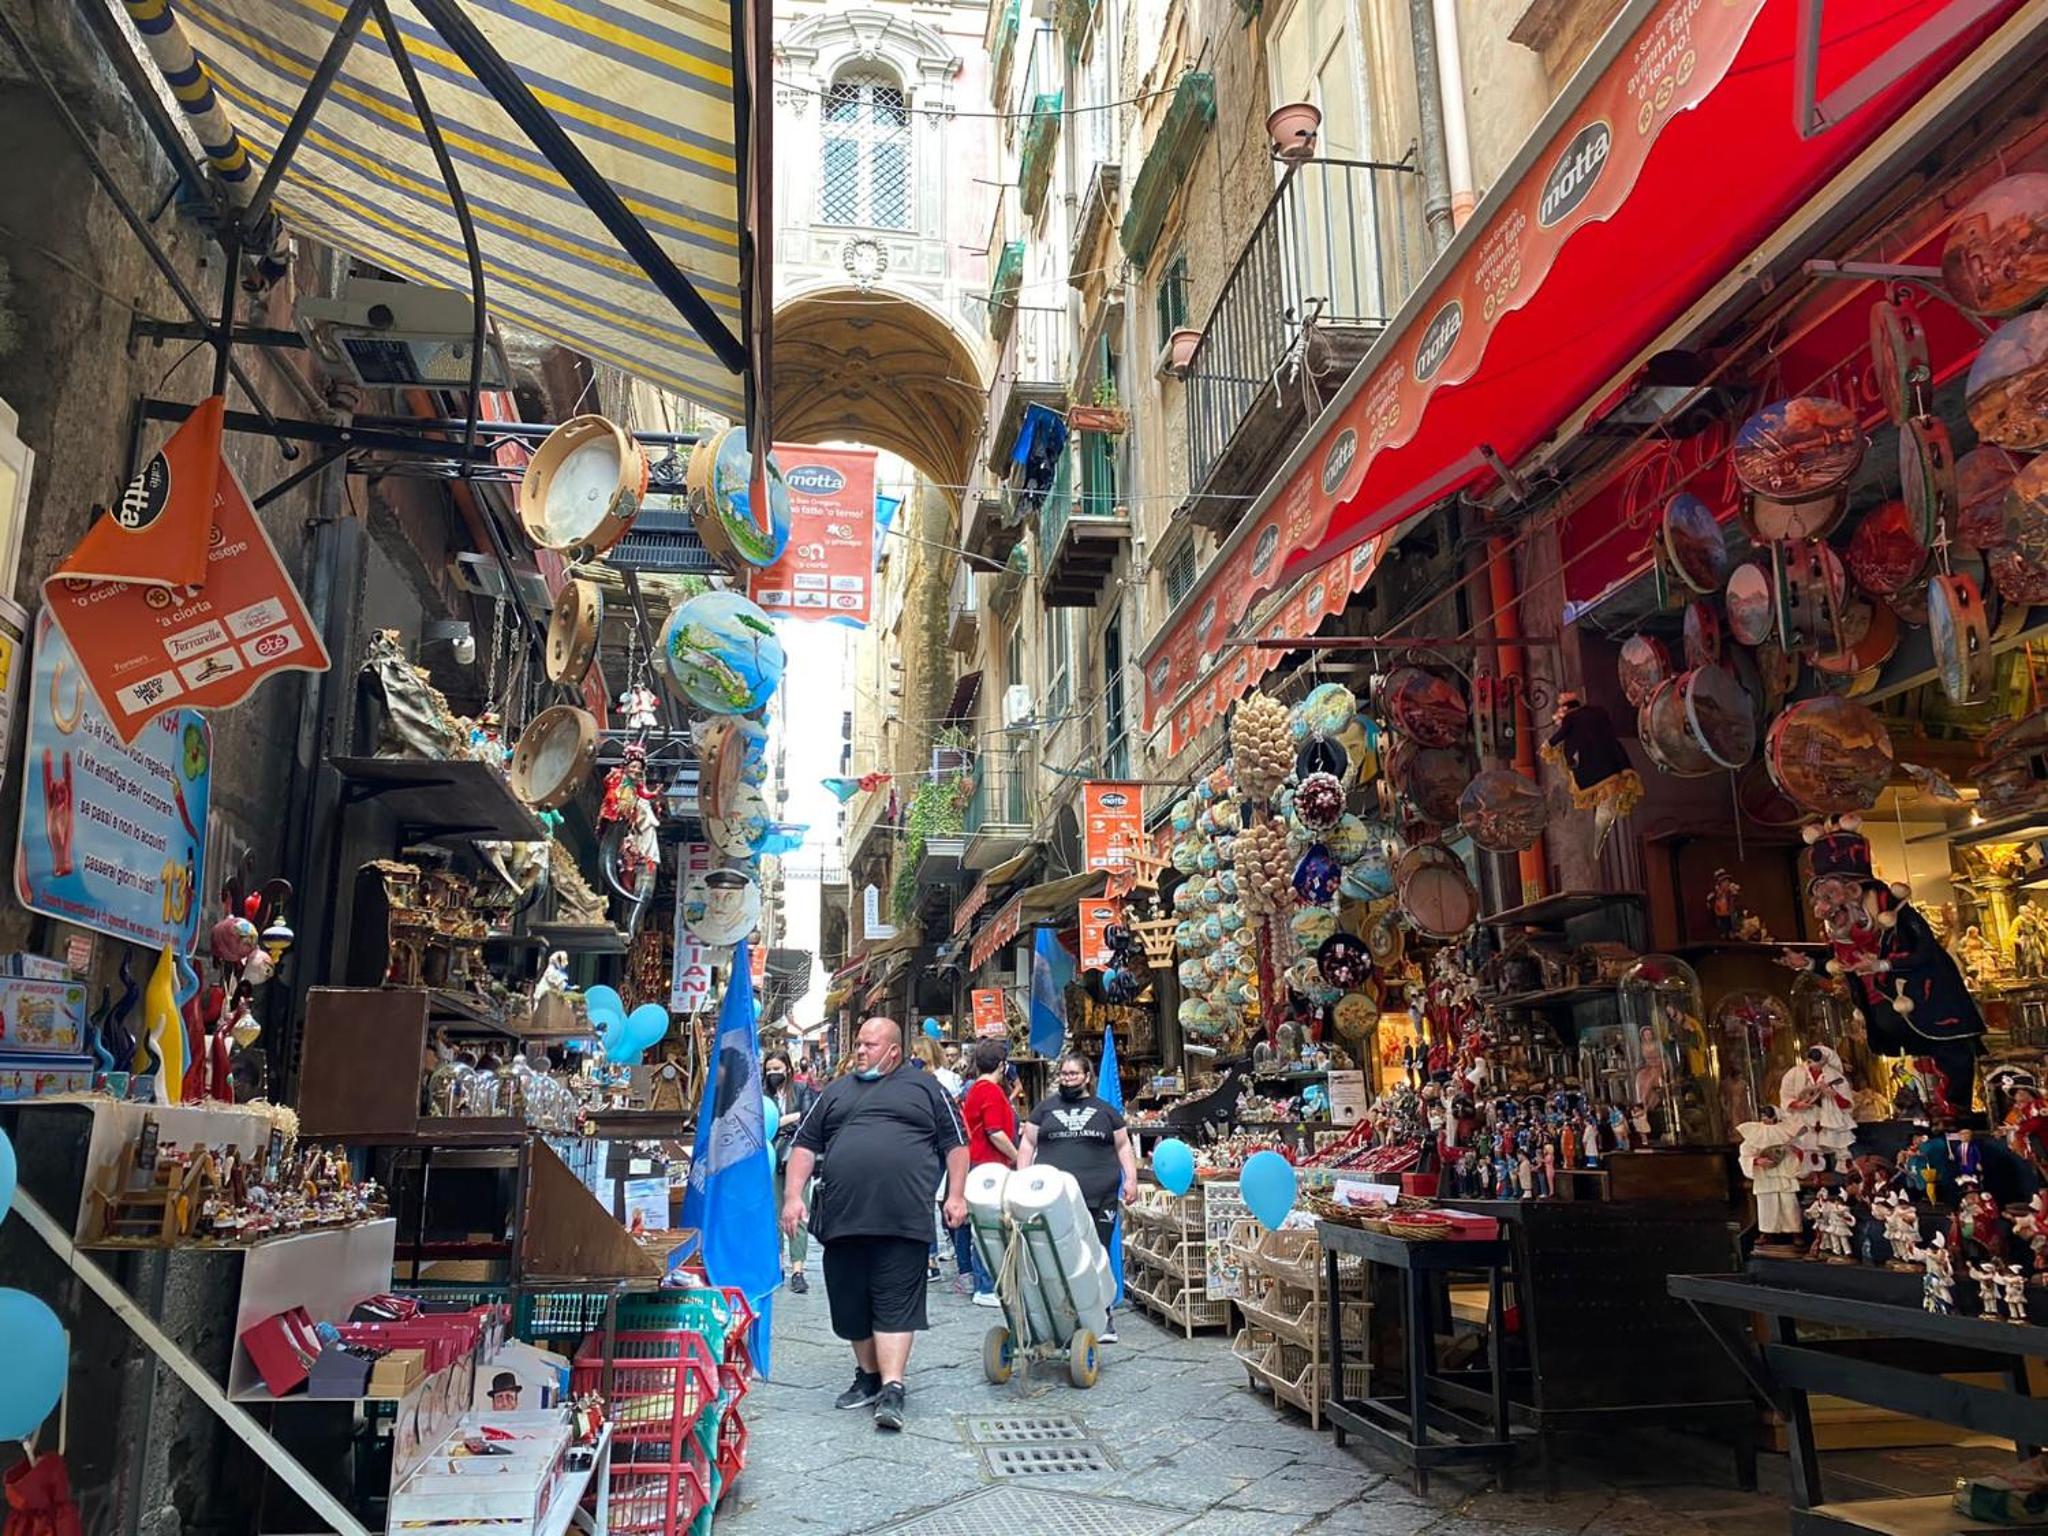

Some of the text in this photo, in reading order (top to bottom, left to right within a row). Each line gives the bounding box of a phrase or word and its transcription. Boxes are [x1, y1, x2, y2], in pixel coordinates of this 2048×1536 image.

[1542, 132, 1608, 223] motta
[1417, 311, 1460, 377] motta
[788, 474, 842, 489] motta
[1325, 438, 1356, 486] motta
[173, 599, 213, 621] ciorta
[170, 626, 222, 656] Ferrarelle
[161, 857, 187, 925] 13
